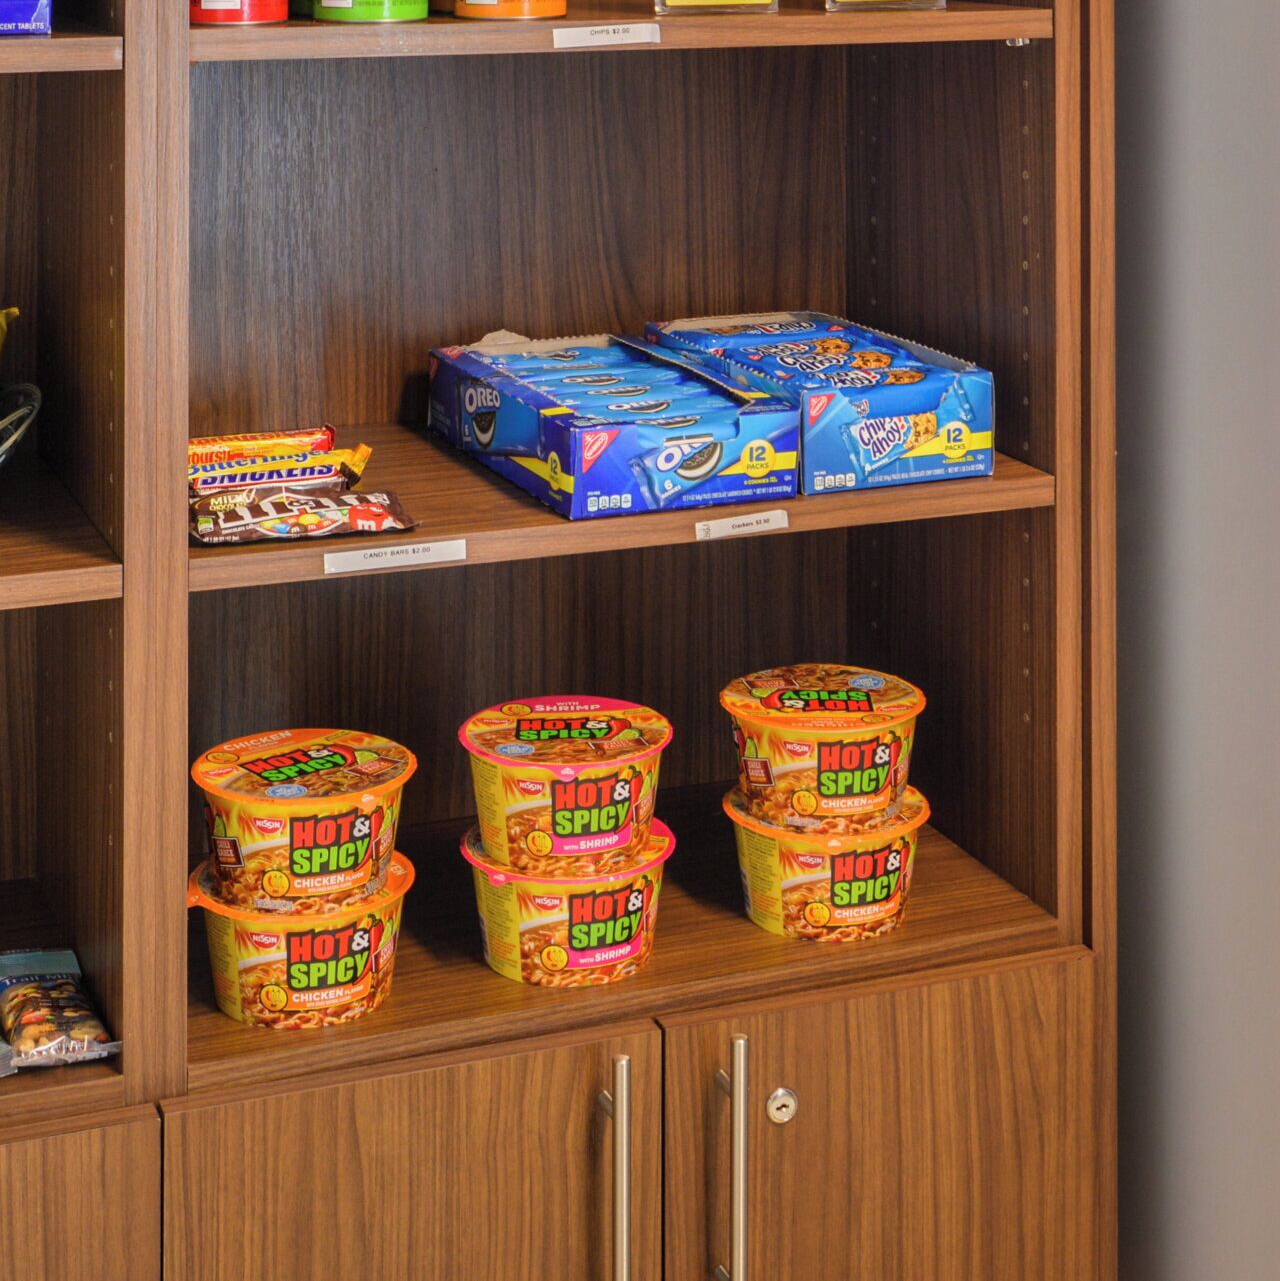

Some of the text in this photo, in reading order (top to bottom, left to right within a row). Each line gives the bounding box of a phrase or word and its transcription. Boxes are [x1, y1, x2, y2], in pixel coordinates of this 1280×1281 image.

[465, 387, 500, 413] OREO
[944, 443, 966, 451] PACKS
[946, 428, 963, 442] 12
[747, 462, 769, 470] PACKS
[749, 446, 766, 462] 12
[732, 522, 753, 530] Crackers
[363, 547, 431, 560] CANDY BARS $2.00
[820, 742, 890, 770] HOT &
[554, 778, 631, 811] HOT &
[820, 765, 889, 795] SPICY
[821, 798, 867, 808] CHICKEN
[292, 815, 371, 847] HOT &
[555, 802, 629, 834] SPICY
[579, 834, 619, 849] SHRIMP
[292, 839, 369, 875] SPICY
[834, 850, 901, 881] HOT &
[294, 874, 345, 889] CHICKEN
[833, 872, 899, 904] SPICY
[571, 889, 644, 923] HOT &
[290, 929, 370, 962] HOT &
[571, 915, 642, 948] SPICY
[290, 953, 368, 989] SPICY
